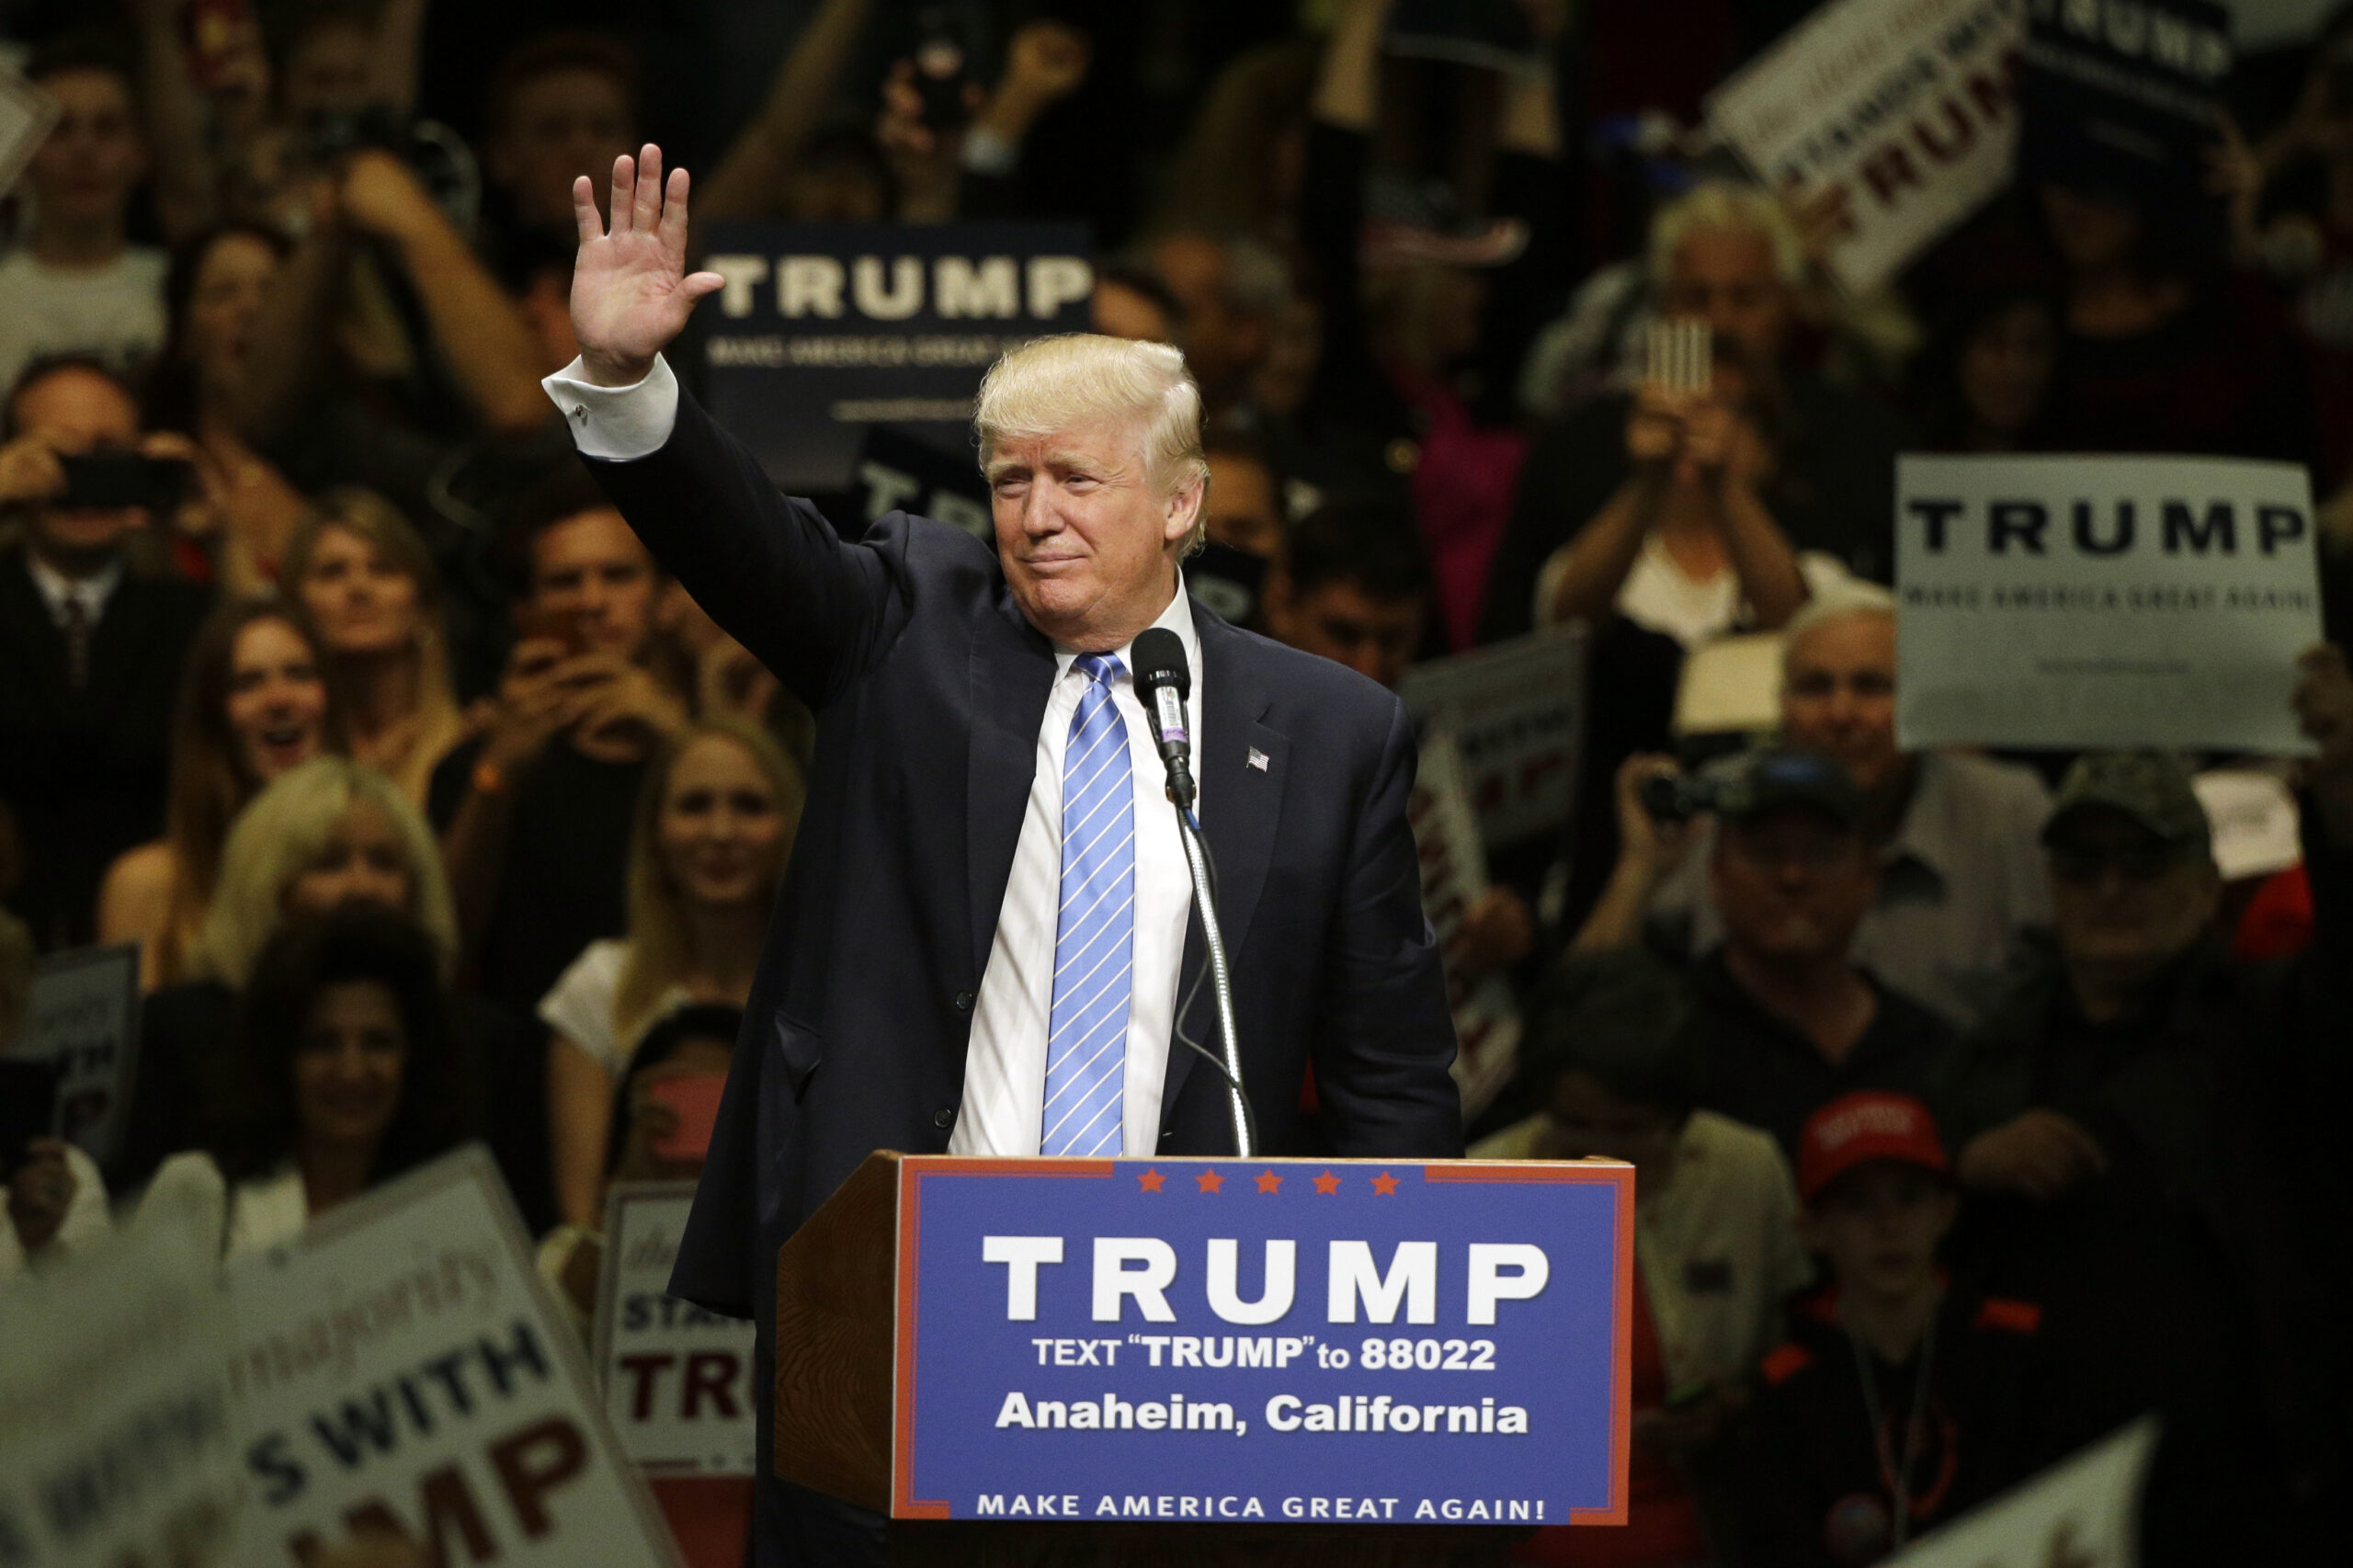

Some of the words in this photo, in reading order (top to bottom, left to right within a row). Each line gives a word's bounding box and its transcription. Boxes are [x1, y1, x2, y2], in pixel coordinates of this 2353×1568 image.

[704, 253, 1094, 320] TRUMP
[1906, 498, 2306, 557] TRUMP
[982, 1235, 1550, 1325] TRUMP
[621, 1351, 756, 1419] TR
[1031, 1338, 1123, 1367] TEXT
[1316, 1343, 1351, 1369] to
[1359, 1337, 1496, 1371] 88022
[309, 1320, 549, 1472] WITH
[995, 1392, 1246, 1437] Anaheim,
[1265, 1394, 1528, 1434] California
[977, 1494, 1080, 1516] MAKE
[1095, 1494, 1265, 1517] AMERICA
[1281, 1496, 1399, 1519] GREAT
[1414, 1498, 1544, 1520] AGAIN!
